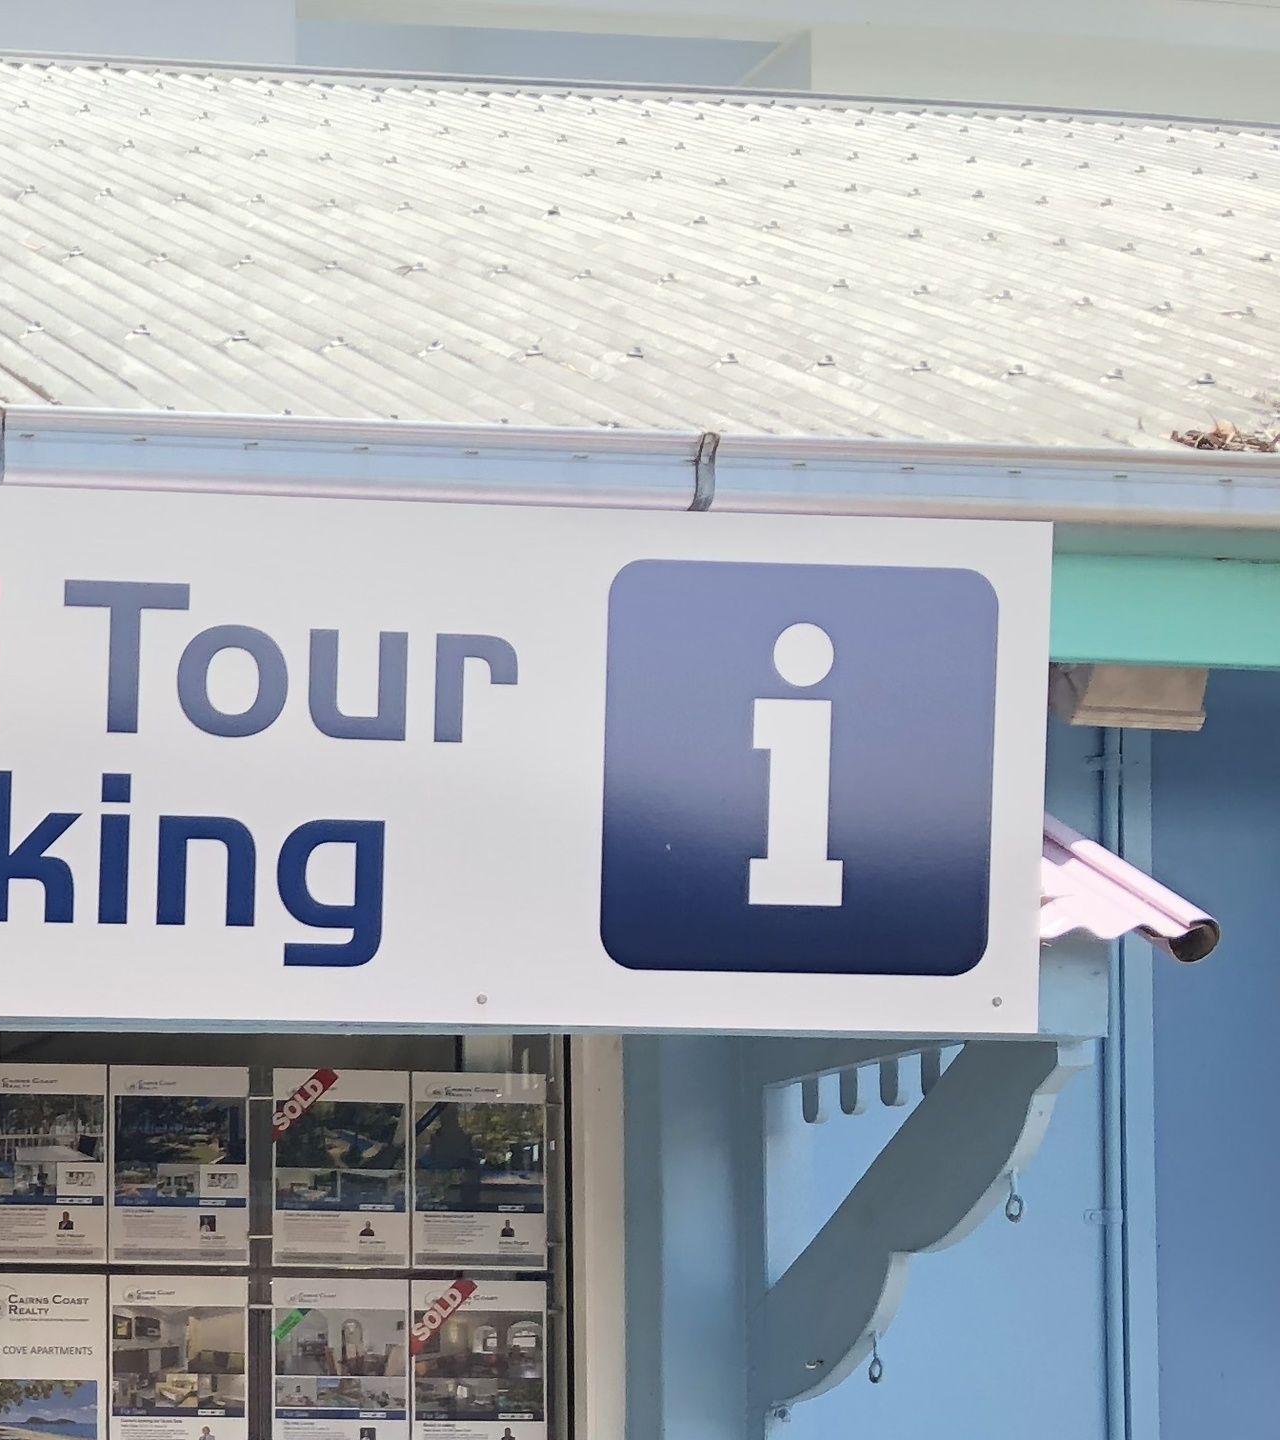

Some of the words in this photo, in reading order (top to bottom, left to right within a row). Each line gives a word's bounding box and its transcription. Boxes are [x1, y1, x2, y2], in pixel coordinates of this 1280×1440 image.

[64, 580, 519, 744] Tour
[272, 1078, 324, 1131] SOLD
[8, 1294, 49, 1304] CAIRNS
[52, 1294, 89, 1304] COAST
[8, 1305, 49, 1315] REALTY
[411, 1287, 463, 1341] SOLD
[3, 1345, 27, 1355] COVE
[30, 1345, 94, 1356] APARTMENTS
